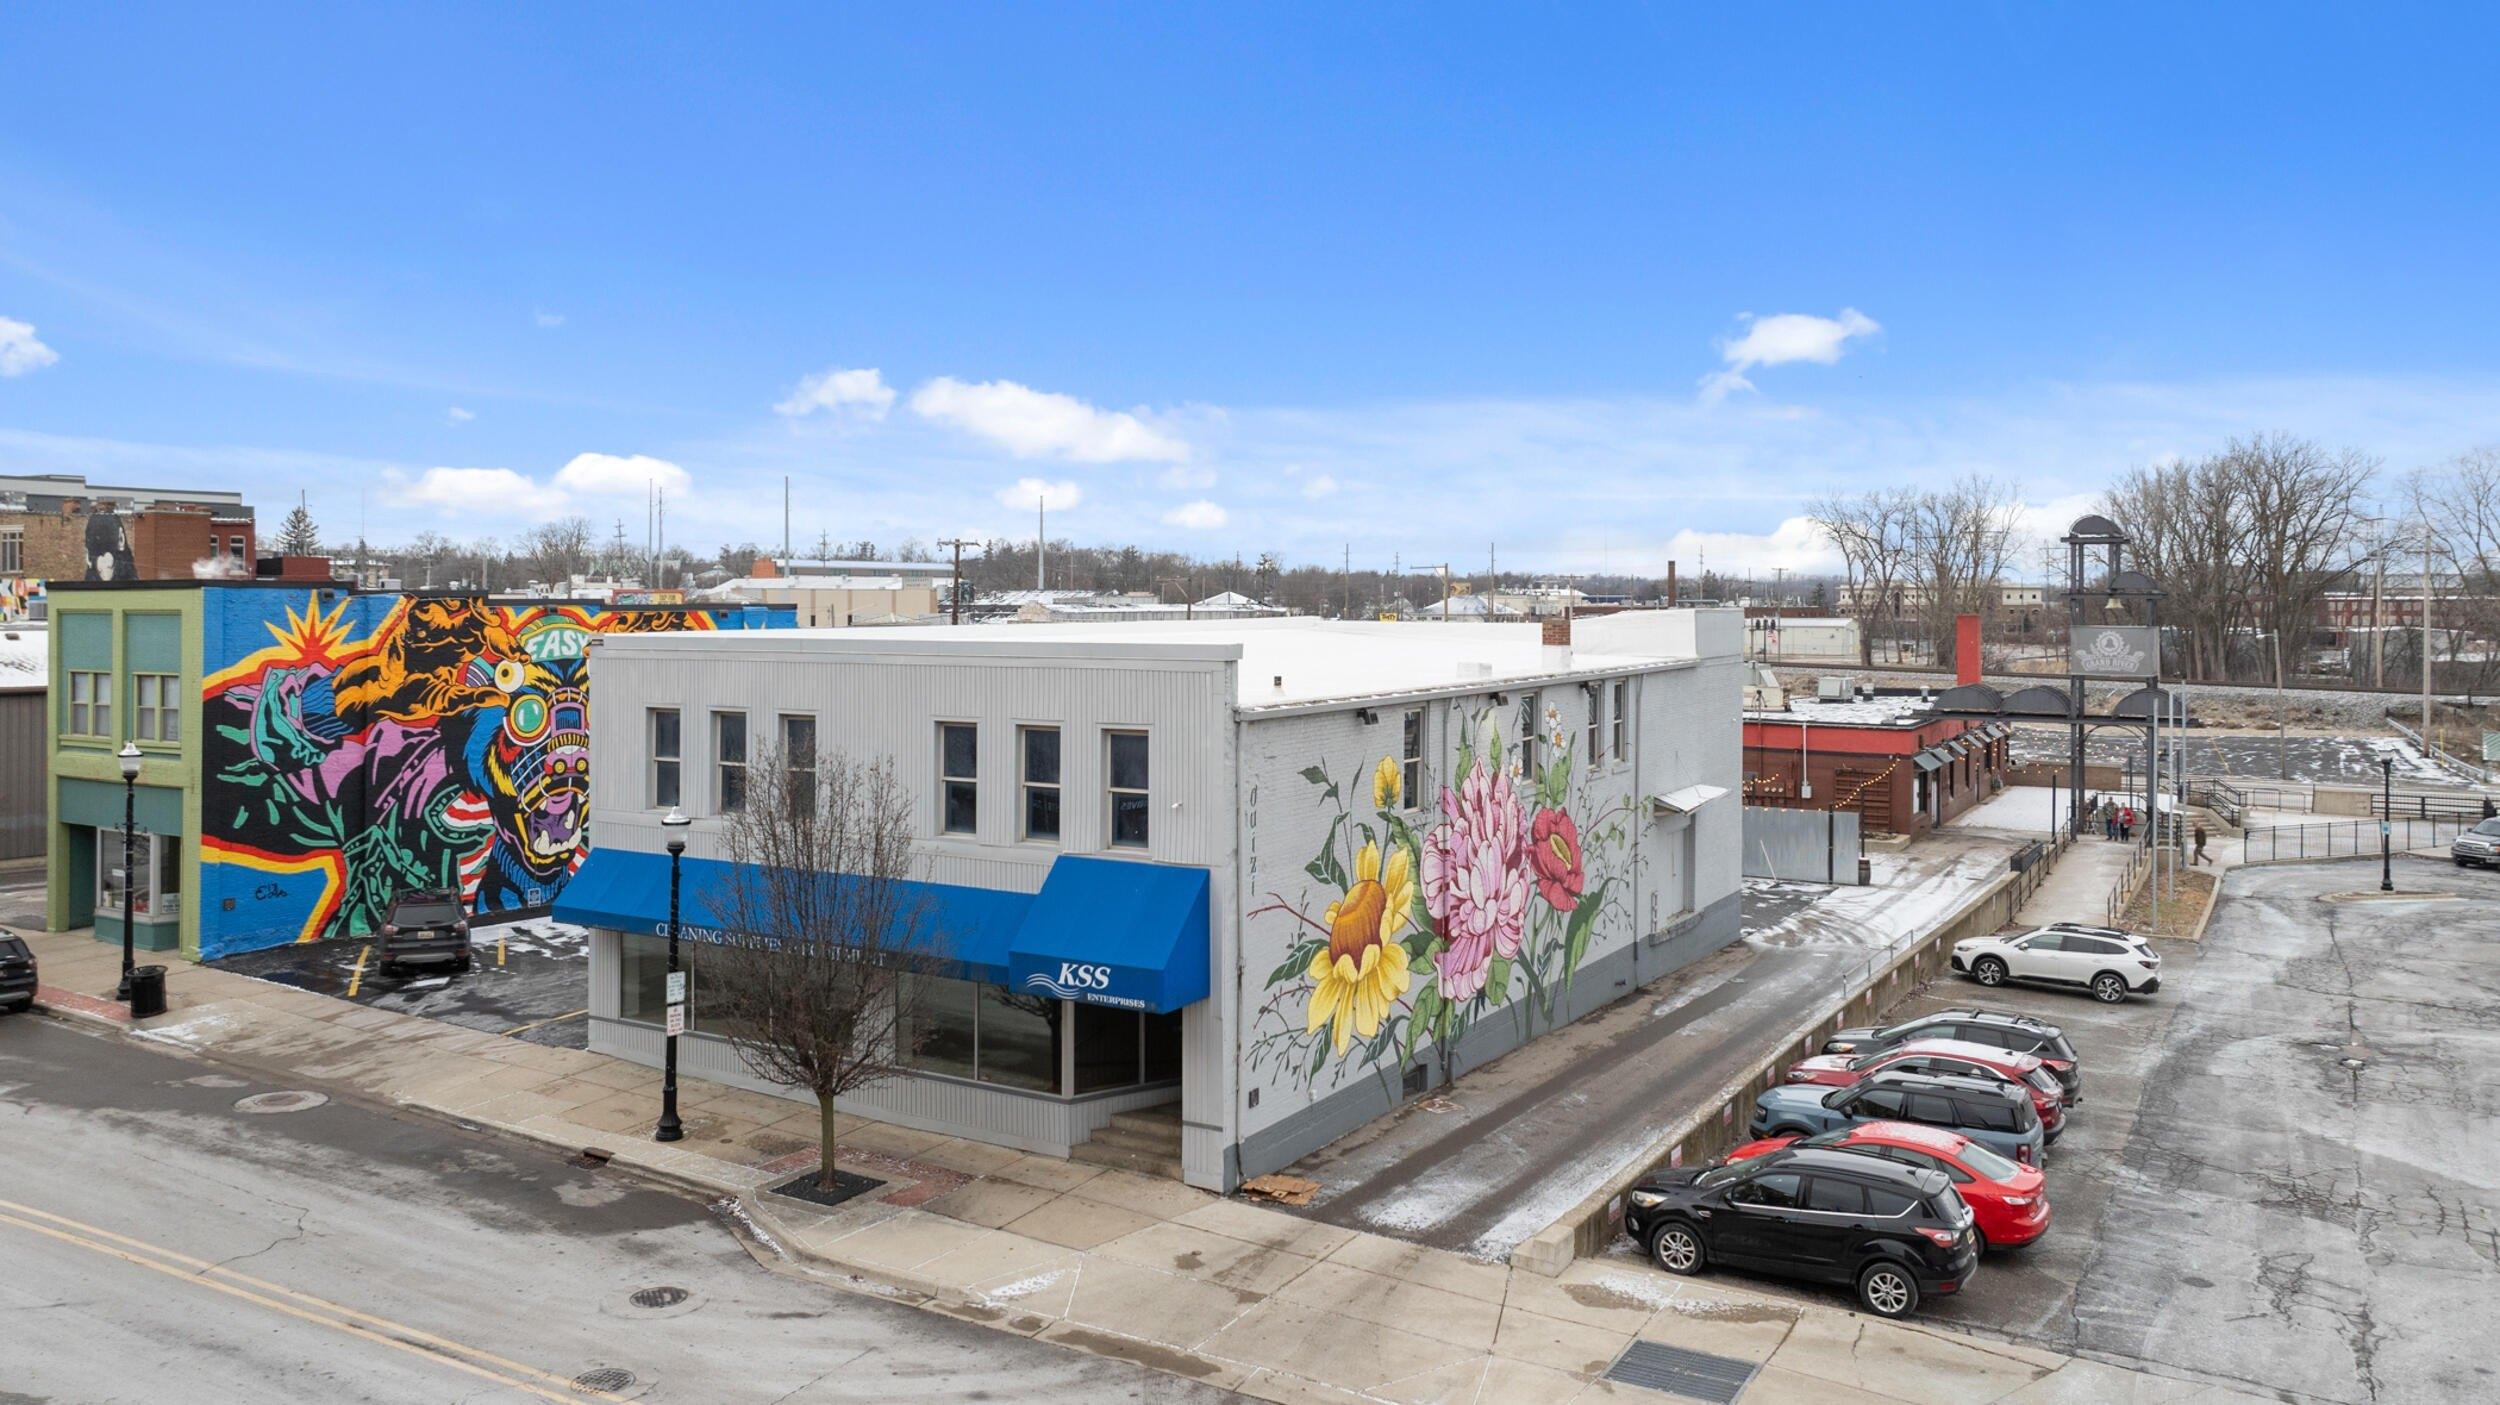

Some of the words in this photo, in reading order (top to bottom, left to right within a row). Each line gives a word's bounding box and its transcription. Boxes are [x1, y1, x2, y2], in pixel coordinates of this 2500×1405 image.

[525, 629, 589, 661] EASY
[655, 921, 723, 945] CLANING
[1057, 962, 1112, 989] KSS
[1087, 992, 1146, 1008] ENTERPRISES
